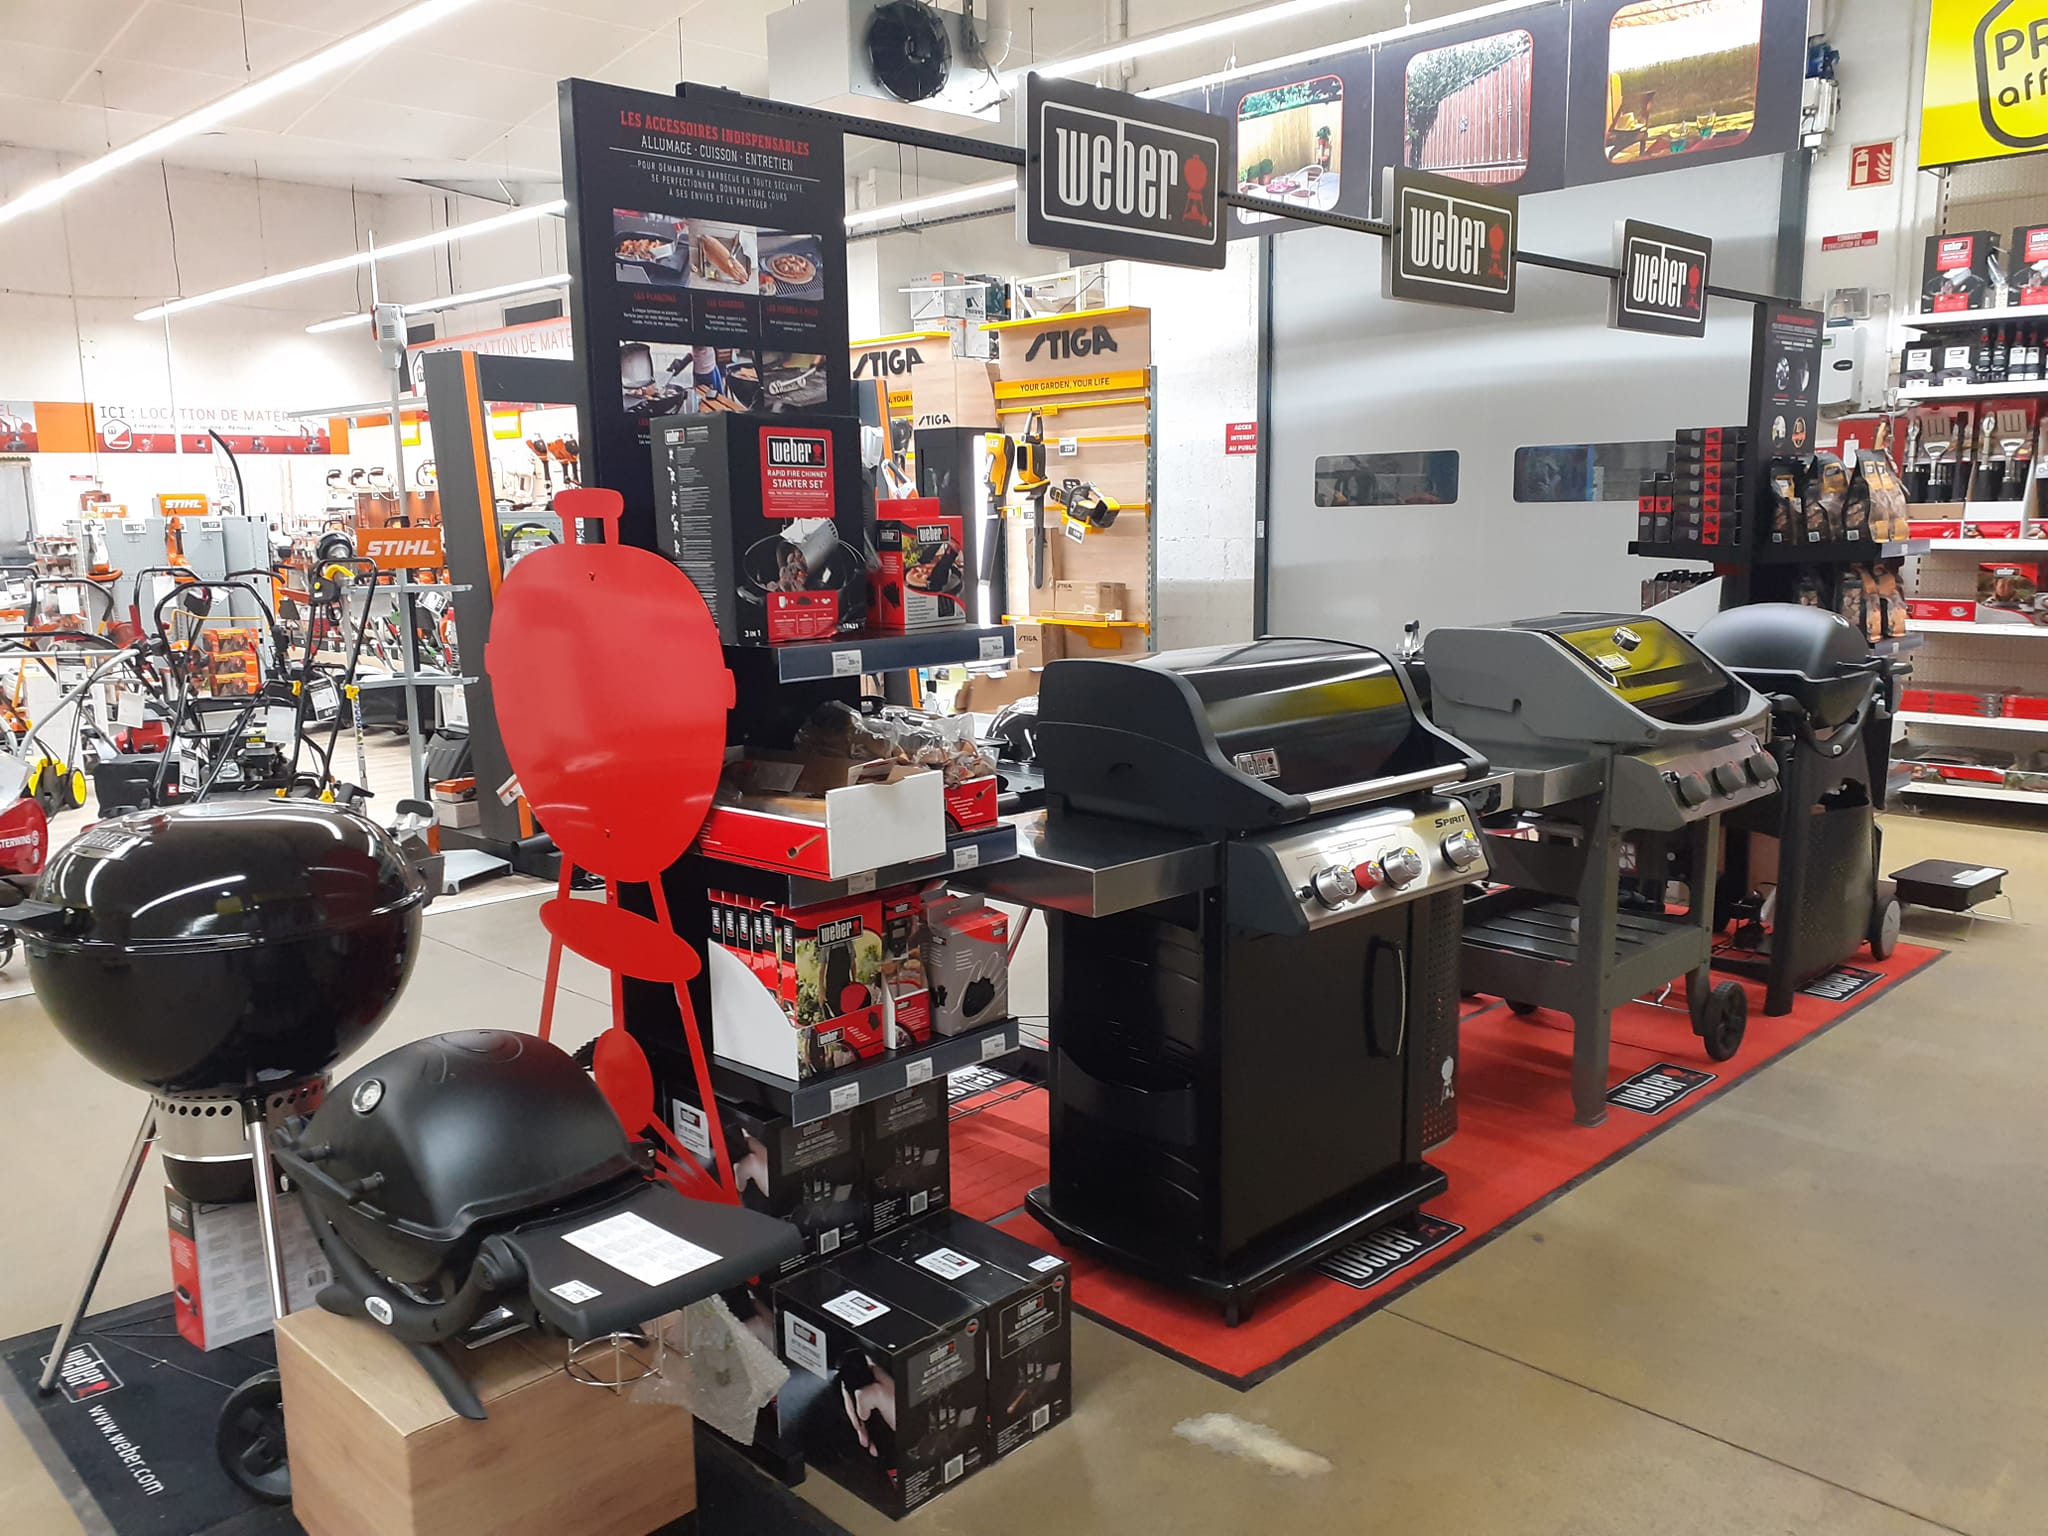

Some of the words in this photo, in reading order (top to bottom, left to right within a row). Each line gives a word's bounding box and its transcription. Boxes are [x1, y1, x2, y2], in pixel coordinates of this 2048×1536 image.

[620, 110, 641, 128] LES
[645, 114, 719, 140] ACCESSOIRES
[721, 127, 809, 156] INDISPENSABLES
[641, 135, 692, 155] ALLUMAGE
[699, 144, 738, 163] CUISSON
[745, 152, 793, 171] ENTRETIEN
[707, 170, 739, 183] BARBECUE
[1056, 119, 1178, 220] weber
[1410, 199, 1486, 276] weber
[1634, 244, 1688, 308] weber
[521, 333, 537, 354] DE
[1025, 325, 1117, 362] STIGA
[852, 347, 924, 379] STIGA
[1020, 382, 1039, 393] YOUR
[1040, 380, 1071, 392] GARDEN,
[1072, 378, 1093, 389] YOUR
[1094, 376, 1110, 387] LIFE
[100, 406, 126, 419] ICI
[221, 409, 239, 421] DE
[918, 414, 951, 426] STIGA
[771, 438, 811, 463] weber
[772, 479, 807, 488] STARTER
[809, 480, 824, 488] SET
[164, 499, 202, 509] STIHL
[919, 525, 942, 542] weber
[365, 540, 436, 557] STIHL
[1018, 635, 1038, 643] STIGA
[1434, 814, 1466, 829] SPIRIT
[821, 919, 852, 943] weber
[1612, 1073, 1687, 1109] weber
[88, 1404, 164, 1496] www.weber.com
